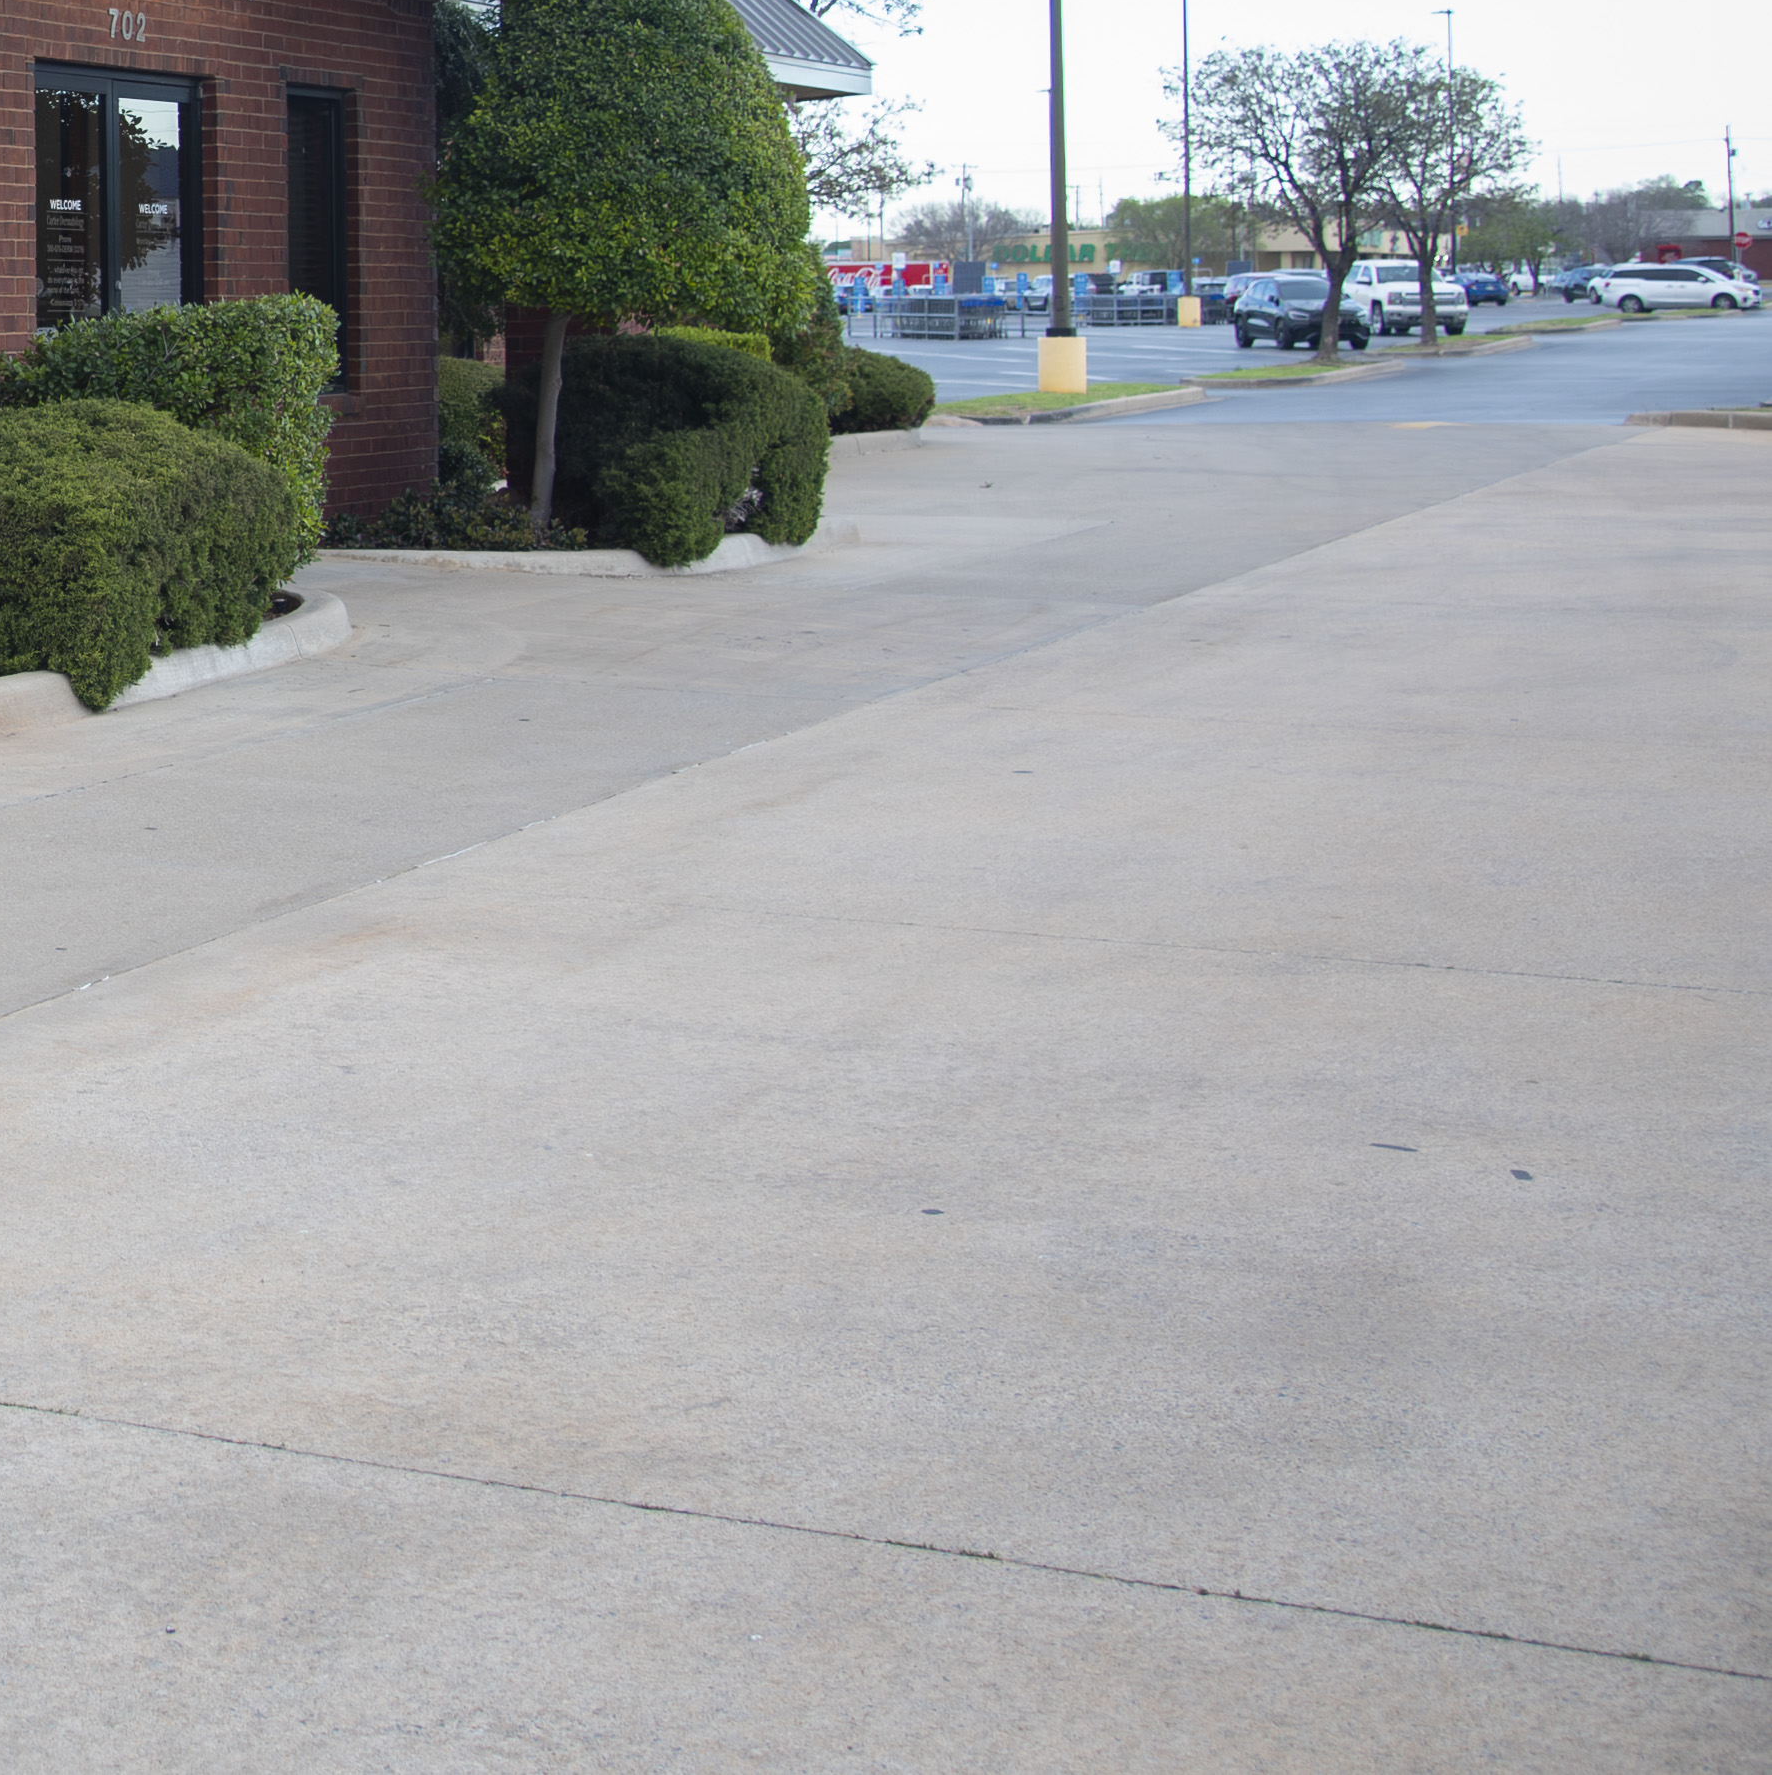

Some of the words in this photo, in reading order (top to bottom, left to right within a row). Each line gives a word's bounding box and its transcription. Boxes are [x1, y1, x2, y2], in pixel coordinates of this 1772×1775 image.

[108, 8, 146, 42] 702
[50, 199, 82, 211] WELCOME
[139, 203, 168, 215] WELCOME
